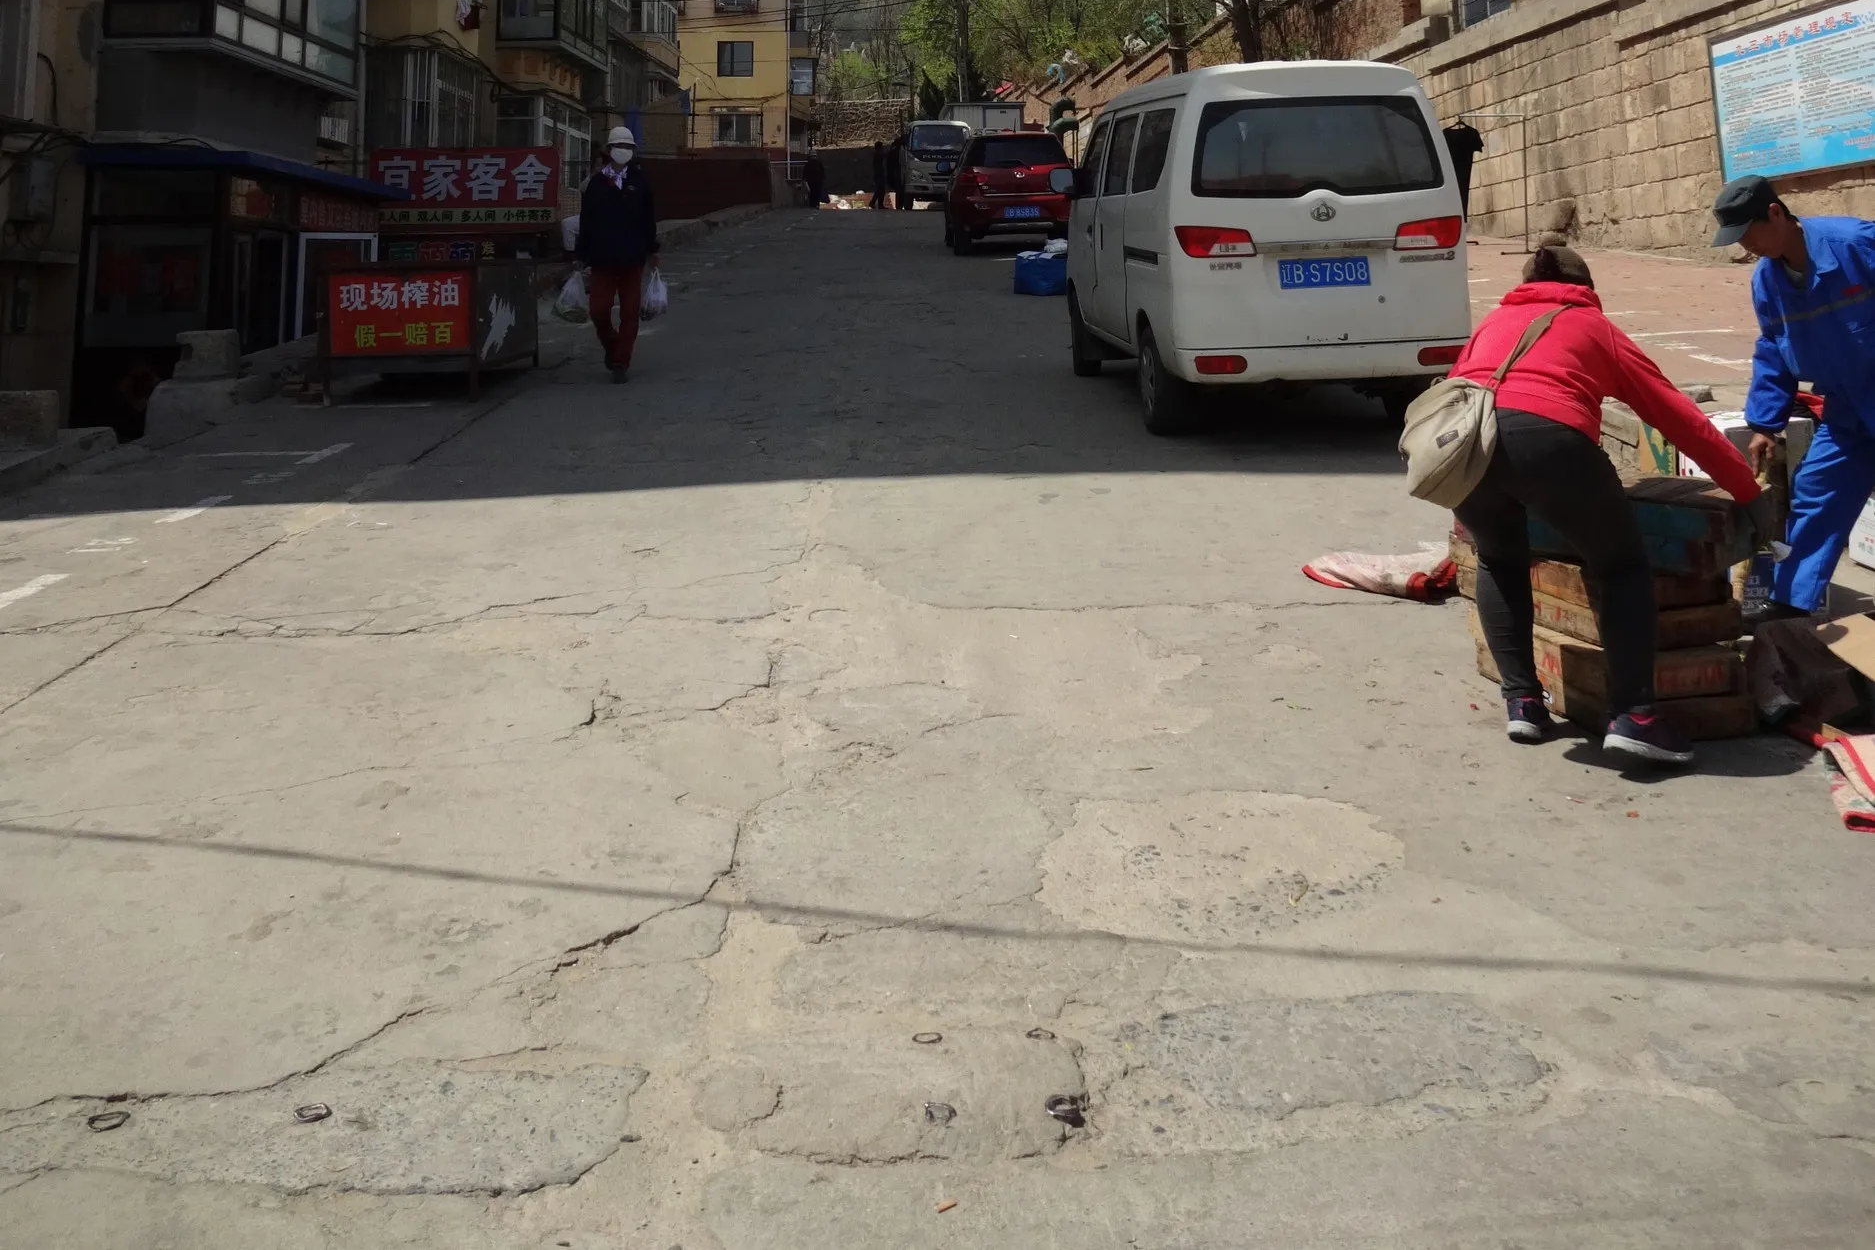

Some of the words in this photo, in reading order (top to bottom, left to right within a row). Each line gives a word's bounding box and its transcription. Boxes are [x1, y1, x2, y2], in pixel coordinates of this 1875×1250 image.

[377, 154, 552, 202] 宜家客舍
[417, 210, 453, 222] 双人间
[461, 210, 496, 222] 多人间
[503, 209, 551, 222] 小件寄存
[340, 280, 460, 311] 现场榨油
[355, 321, 455, 349] 假一赔百
